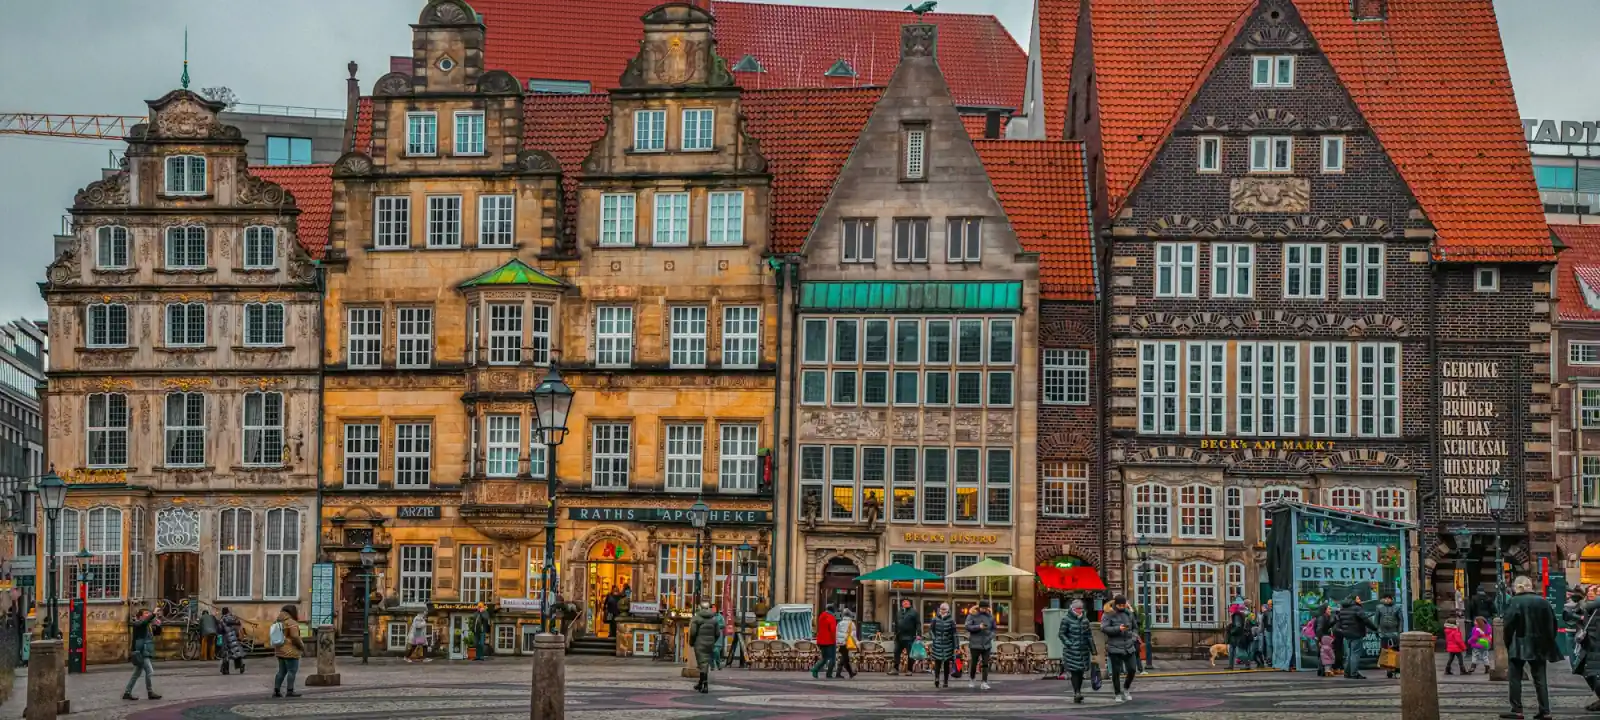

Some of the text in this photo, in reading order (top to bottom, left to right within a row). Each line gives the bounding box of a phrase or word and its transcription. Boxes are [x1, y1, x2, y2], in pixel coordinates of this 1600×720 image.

[1443, 362, 1499, 378] GEDENKE
[1443, 382, 1467, 397] DER
[1443, 399, 1499, 417] BRÜDER,
[1444, 420, 1490, 436] DIE DAS
[1255, 440, 1277, 449] AM
[1283, 441, 1336, 450] MARKT
[1444, 440, 1509, 456] SCHICKSAL
[1444, 459, 1500, 475] UNSERER
[580, 509, 755, 522] RATHS APOHEKE
[950, 534, 997, 544] BISTRO
[1301, 548, 1372, 561] LICHTER
[1301, 567, 1378, 579] DER CITY
